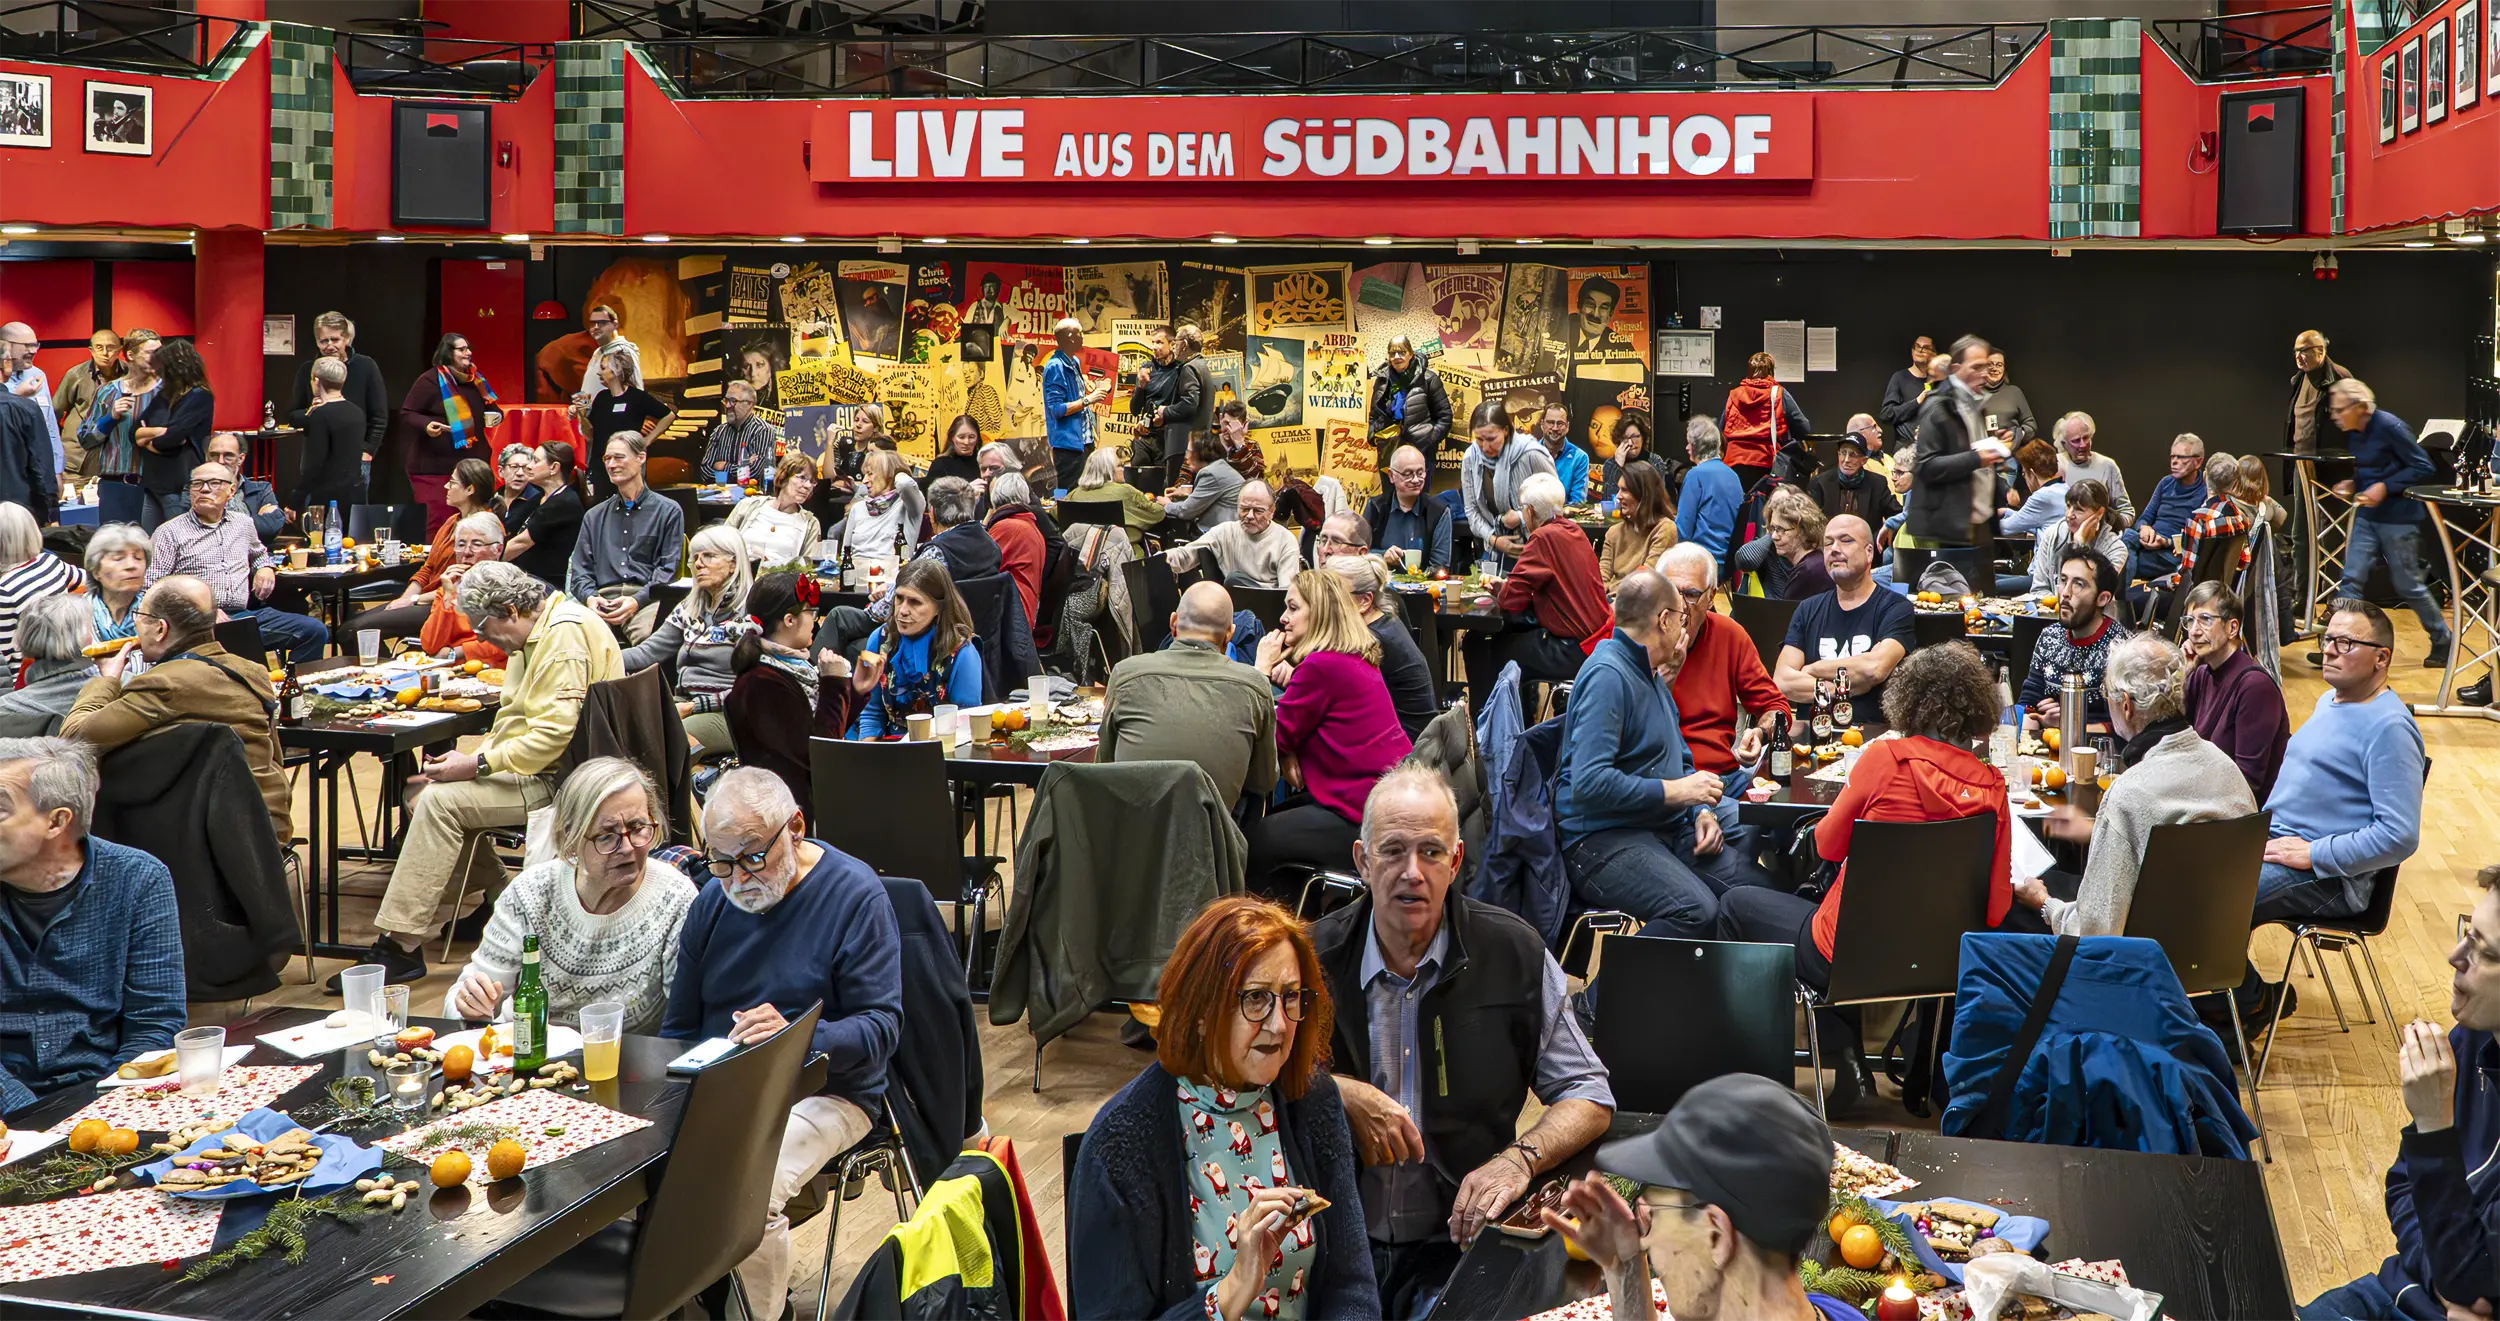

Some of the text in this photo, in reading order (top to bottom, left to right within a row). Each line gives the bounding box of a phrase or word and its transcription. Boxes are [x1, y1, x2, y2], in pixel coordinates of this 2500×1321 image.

[849, 109, 1772, 178] LIVE AUS DEM SÜDBAHNHOF
[918, 266, 945, 278] Chris
[730, 272, 771, 301] FATS
[918, 275, 950, 287] Barber
[1432, 275, 1496, 304] TREMELOES
[1009, 286, 1066, 312] Acker
[1322, 334, 1351, 346] ABBI
[1574, 350, 1590, 360] und
[1591, 350, 1603, 360] ein
[789, 372, 814, 386] DIXIE
[842, 367, 865, 386] DIXIE
[1437, 369, 1472, 388] FATS
[1484, 375, 1557, 391] SUPERCHARGE
[1308, 395, 1363, 409] WIZARDS
[1271, 429, 1311, 439] CLIMAX
